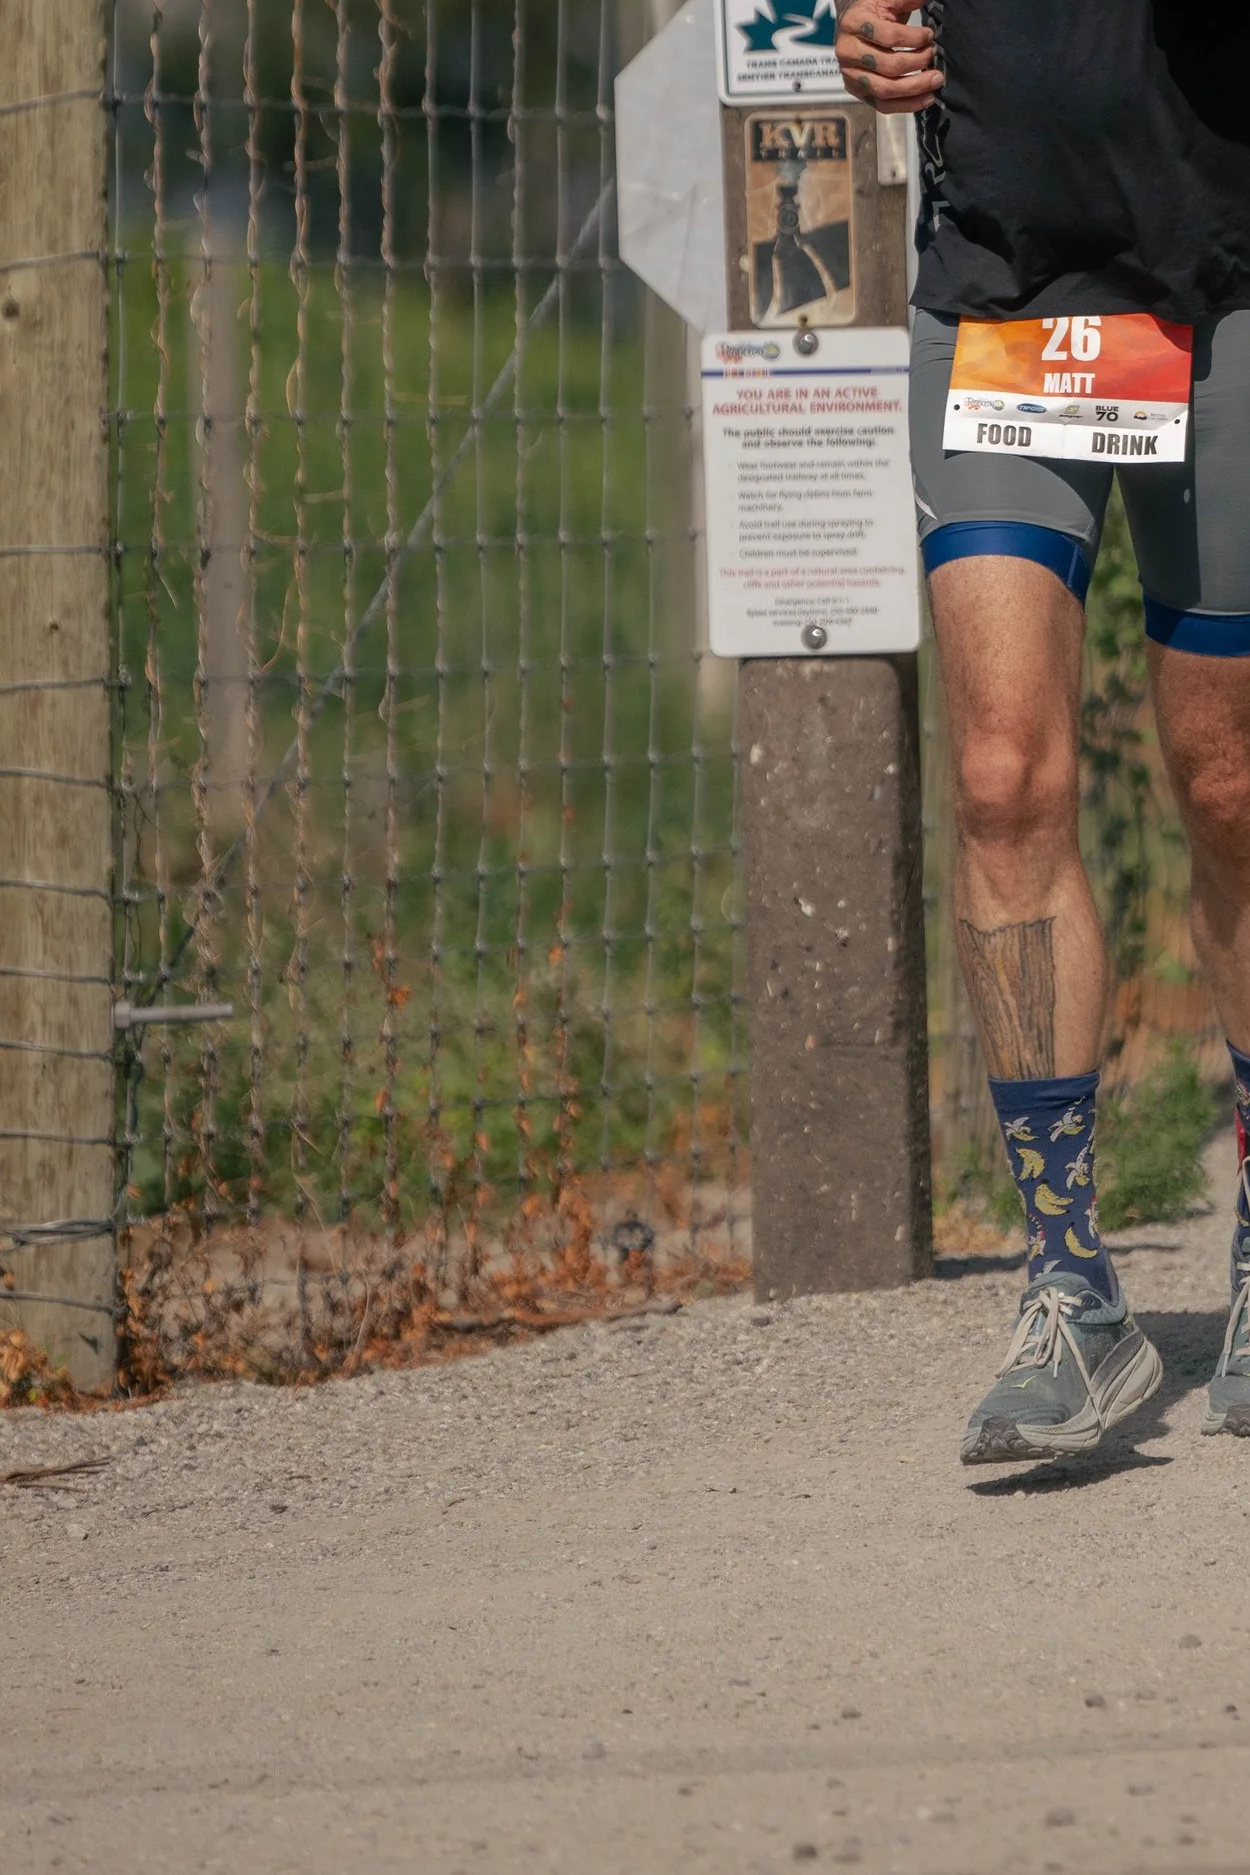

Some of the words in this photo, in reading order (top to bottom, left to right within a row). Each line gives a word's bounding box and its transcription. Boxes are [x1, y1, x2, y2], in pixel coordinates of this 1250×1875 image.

[746, 58, 777, 69] TRANS
[780, 57, 818, 67] CANADA
[759, 120, 839, 148] KVR
[1041, 315, 1101, 361] 26
[1044, 373, 1095, 394] MATT
[737, 388, 762, 400] YOU
[768, 388, 791, 399] ARE
[796, 388, 807, 398] IN
[813, 386, 829, 398] AN
[835, 385, 878, 397] ACTIVE
[713, 401, 804, 415] AGRICULTURAL
[1096, 412, 1118, 421] 70
[723, 427, 740, 437] The
[744, 427, 774, 439] public
[778, 426, 810, 436] should
[814, 426, 853, 436] exercise
[857, 426, 893, 434] caution
[977, 423, 1032, 447] FOOD
[742, 438, 760, 448] and
[764, 437, 803, 447] observe
[807, 437, 822, 446] the
[1092, 432, 1158, 455] DRINK
